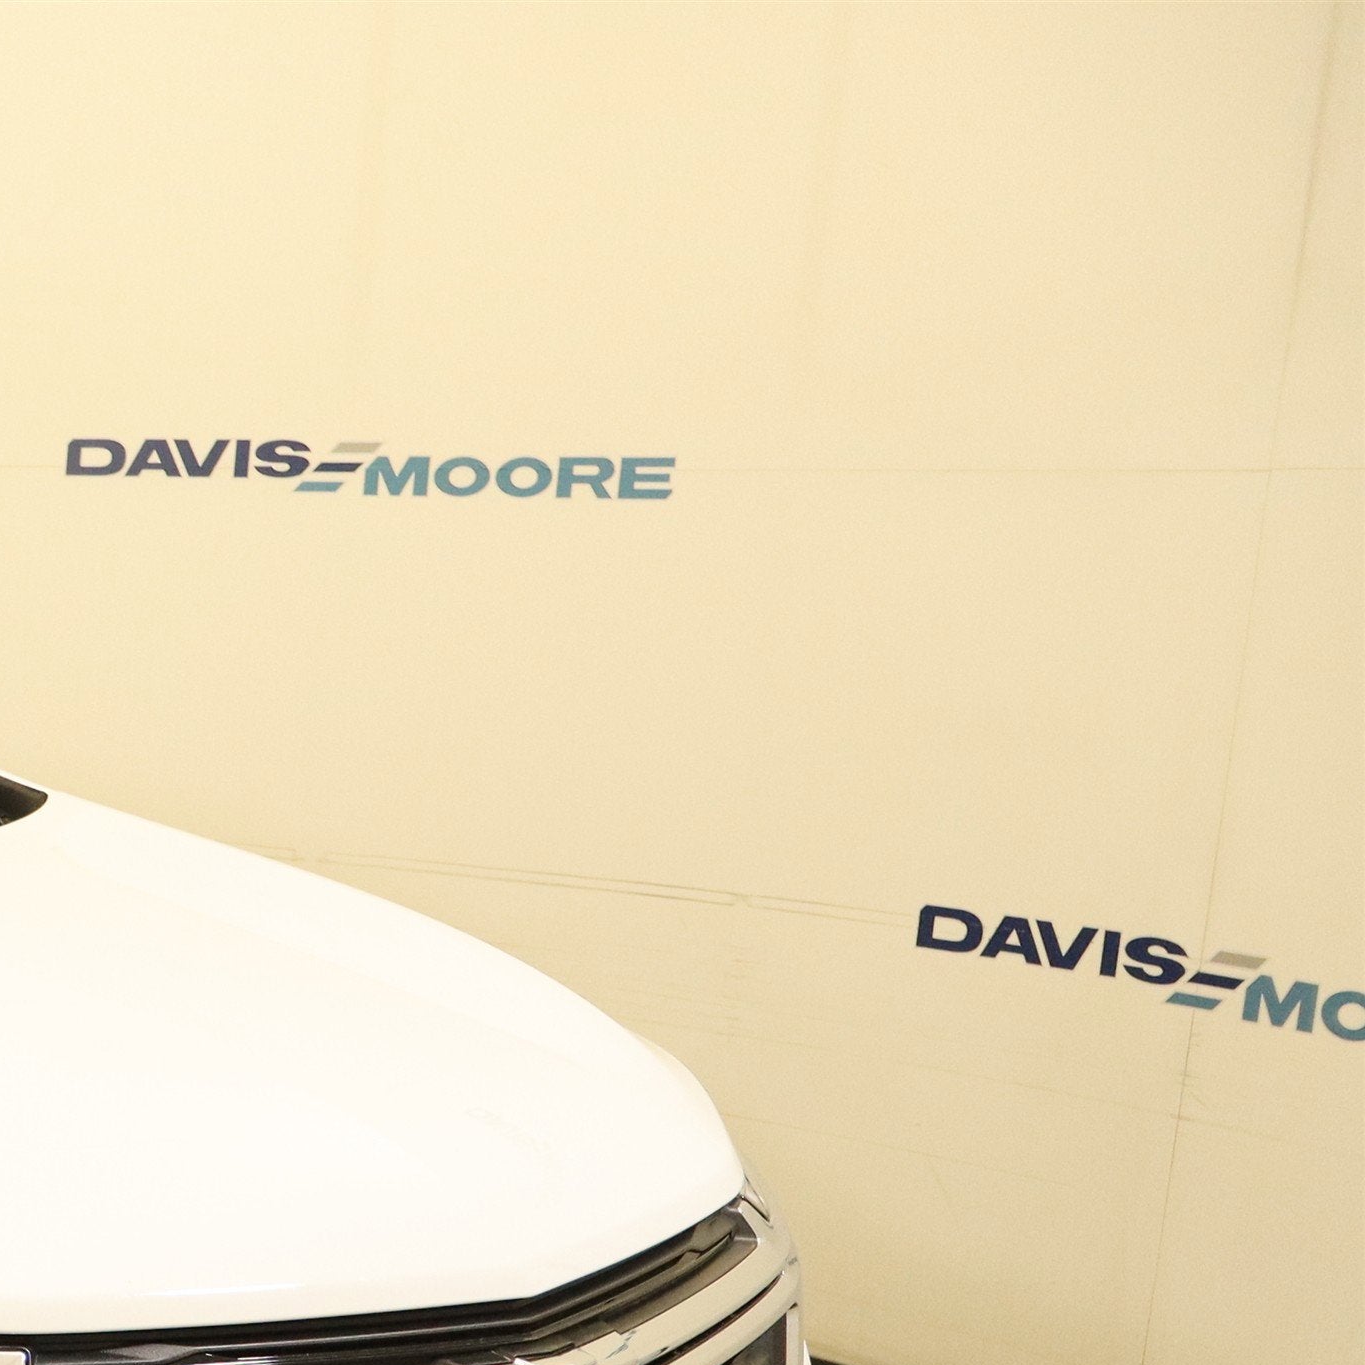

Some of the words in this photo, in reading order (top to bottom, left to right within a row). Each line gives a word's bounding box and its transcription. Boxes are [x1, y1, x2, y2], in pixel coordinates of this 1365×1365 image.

[65, 438, 312, 478] DAVIS
[363, 455, 676, 500] MOORE
[915, 904, 1188, 985] DAVIS
